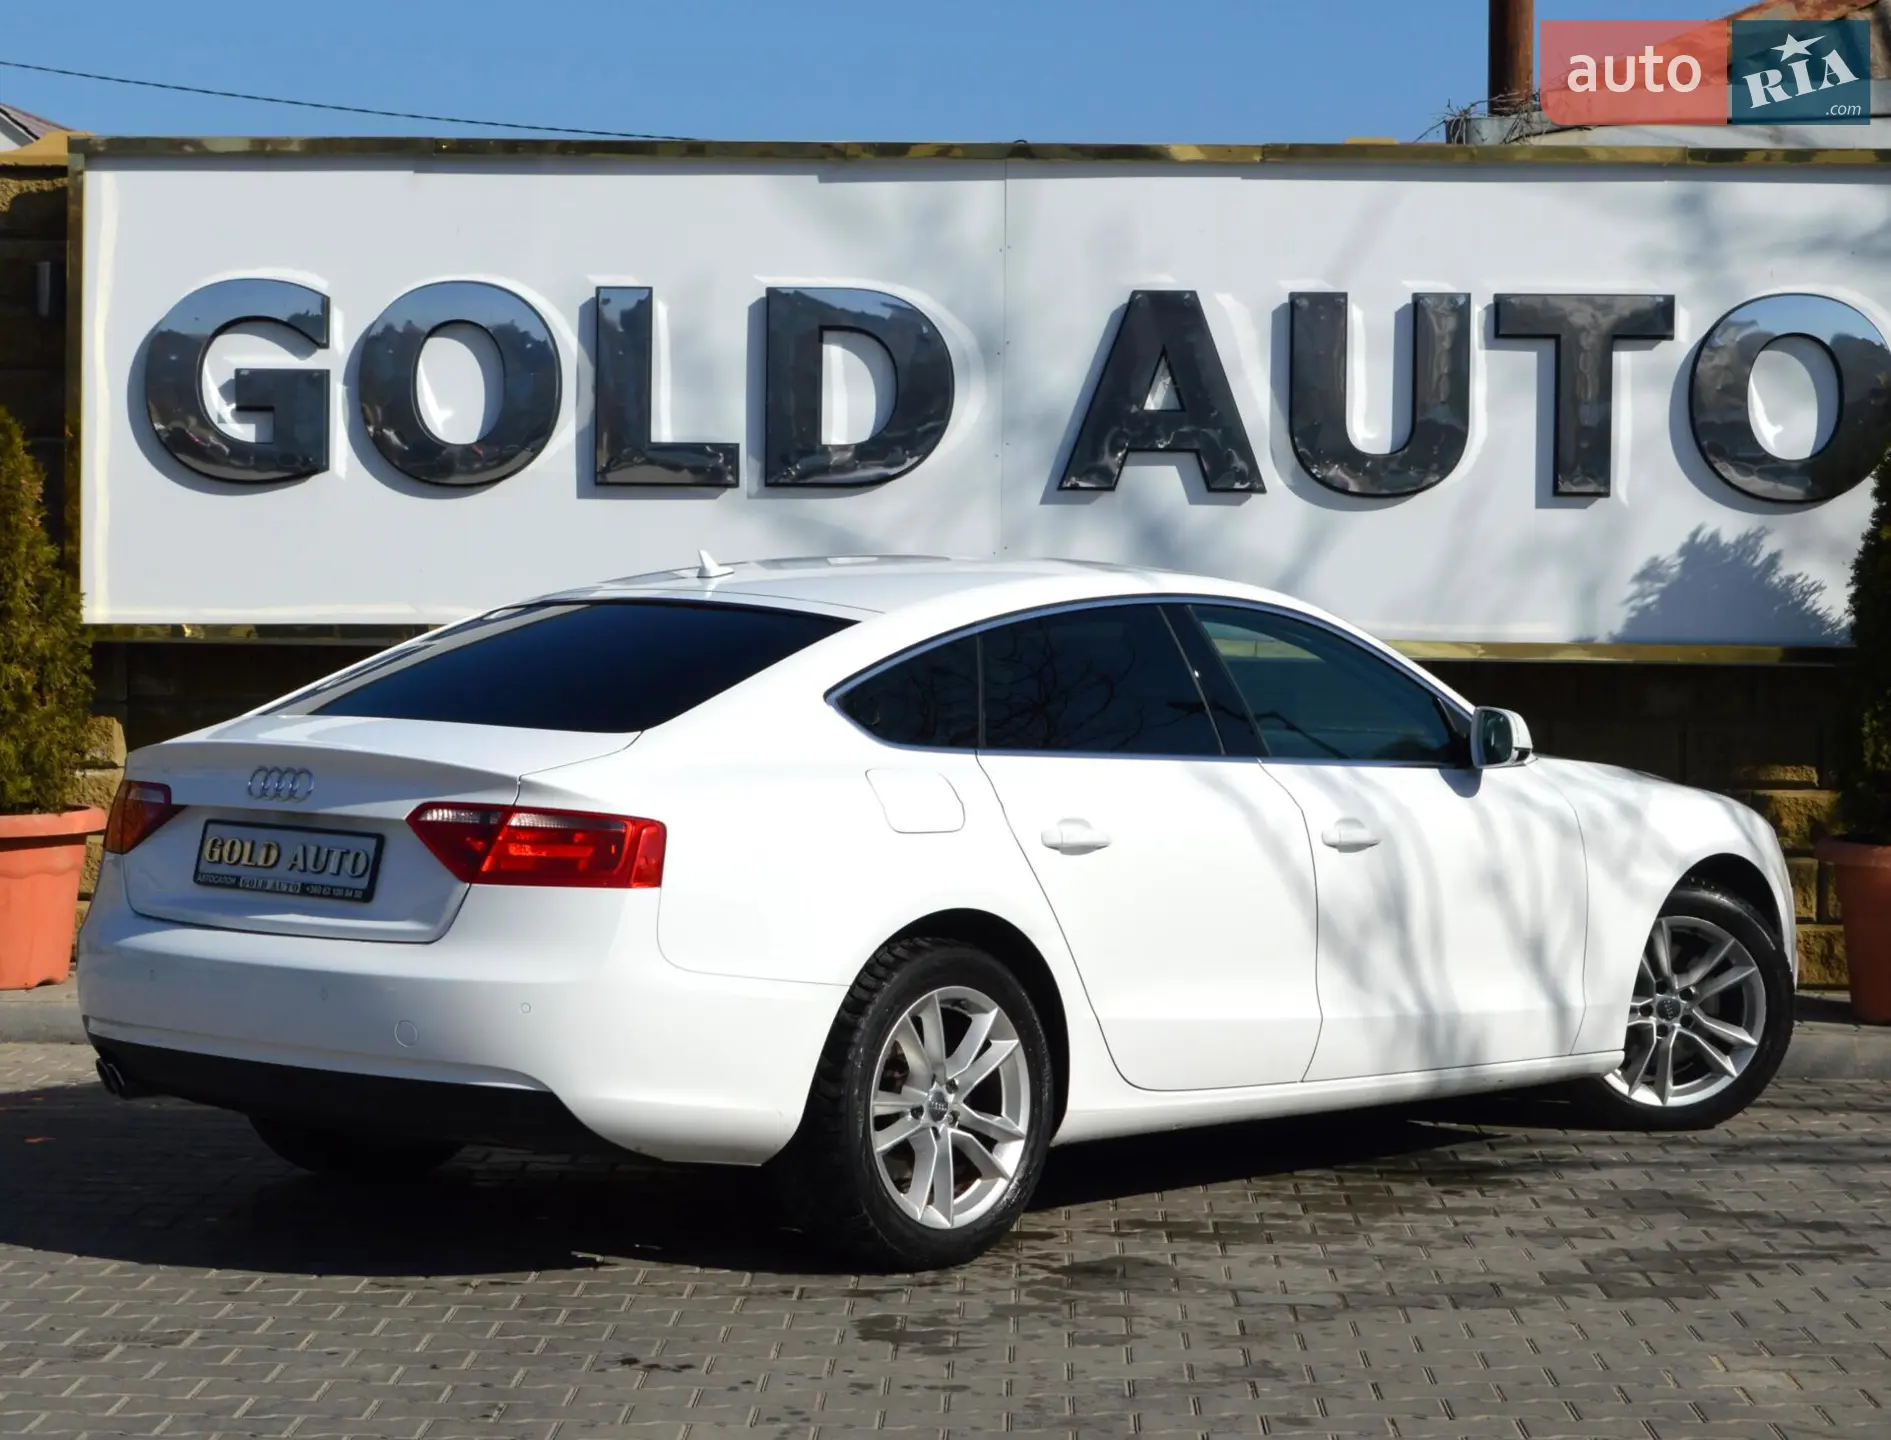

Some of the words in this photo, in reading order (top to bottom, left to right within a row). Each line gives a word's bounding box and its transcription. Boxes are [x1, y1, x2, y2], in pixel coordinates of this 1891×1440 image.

[144, 278, 956, 488] GOLD
[1058, 289, 1891, 504] AUTO
[203, 836, 282, 868] GOLD
[286, 844, 369, 878] AUTO
